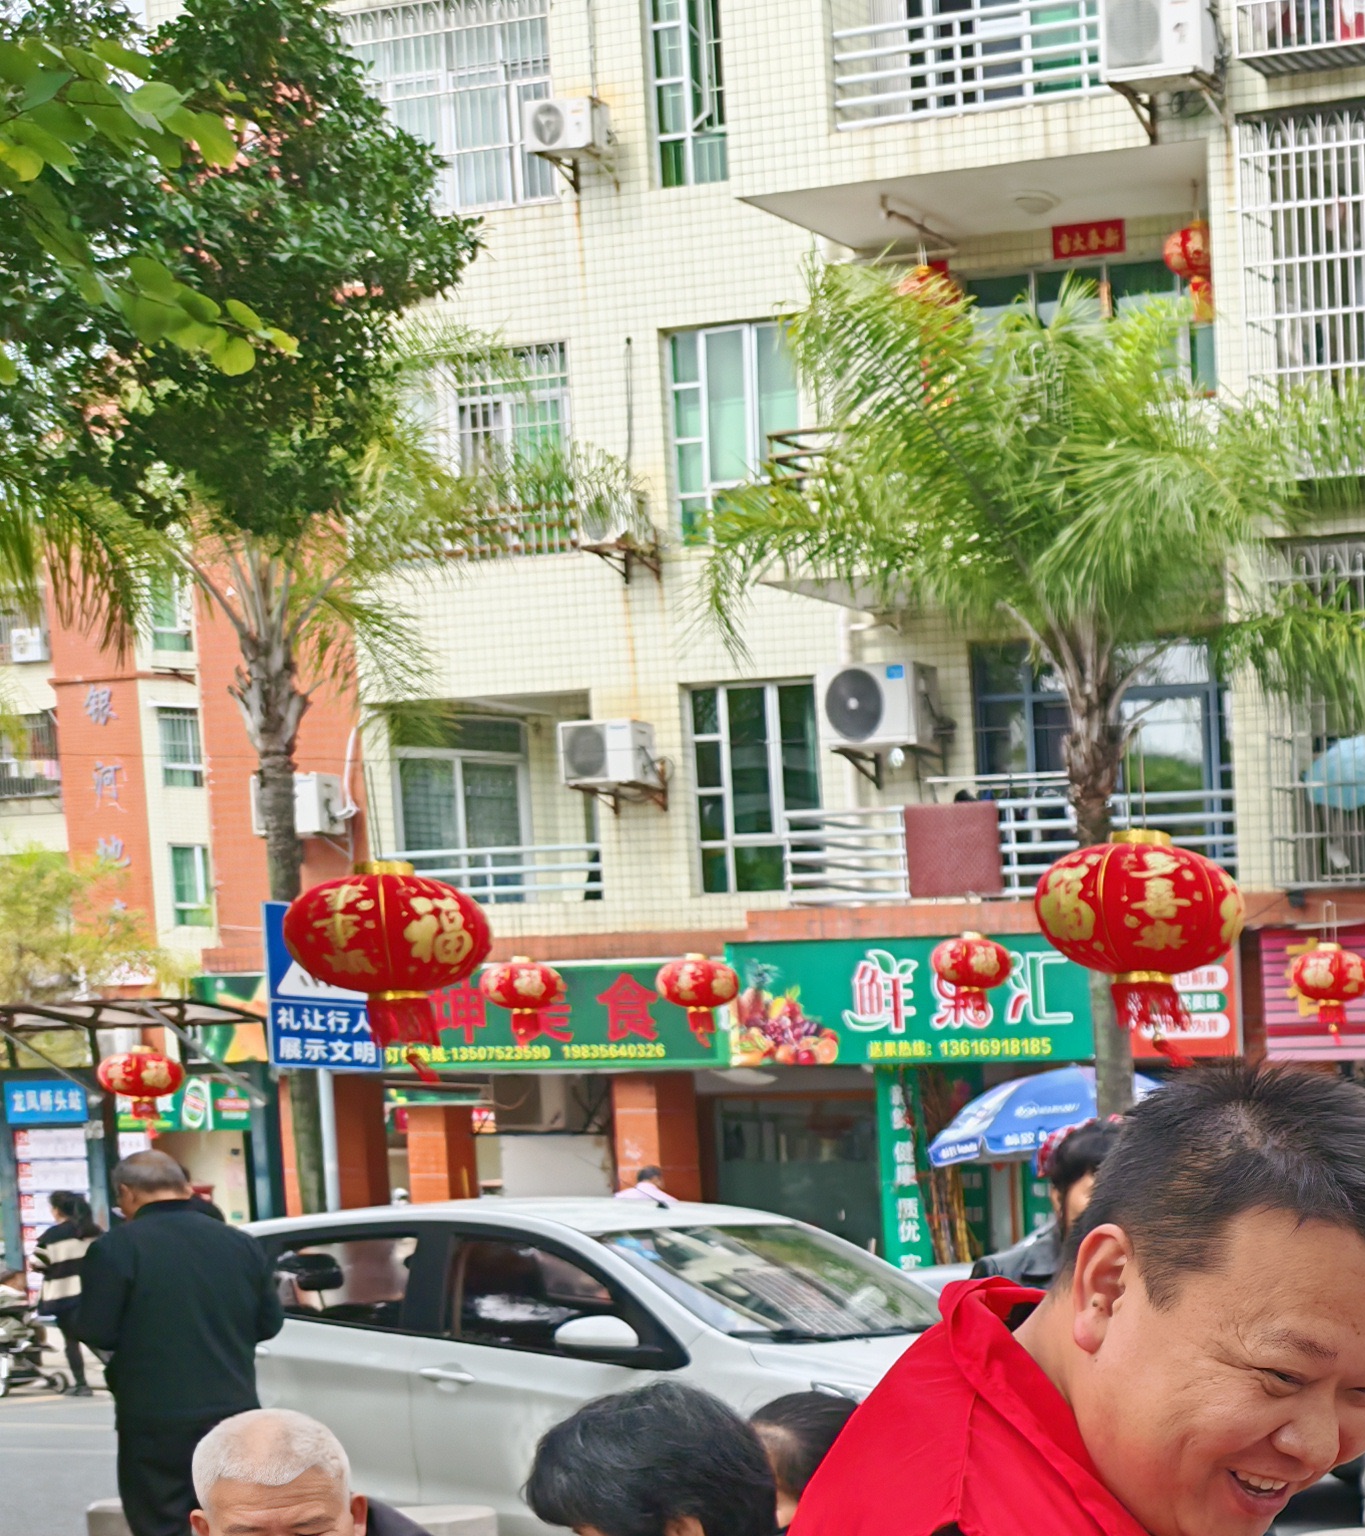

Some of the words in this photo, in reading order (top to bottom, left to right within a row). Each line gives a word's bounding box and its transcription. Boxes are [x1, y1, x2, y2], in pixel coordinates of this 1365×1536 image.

[277, 1006, 373, 1034] 礼让行人
[279, 1036, 377, 1064] 展示文明
